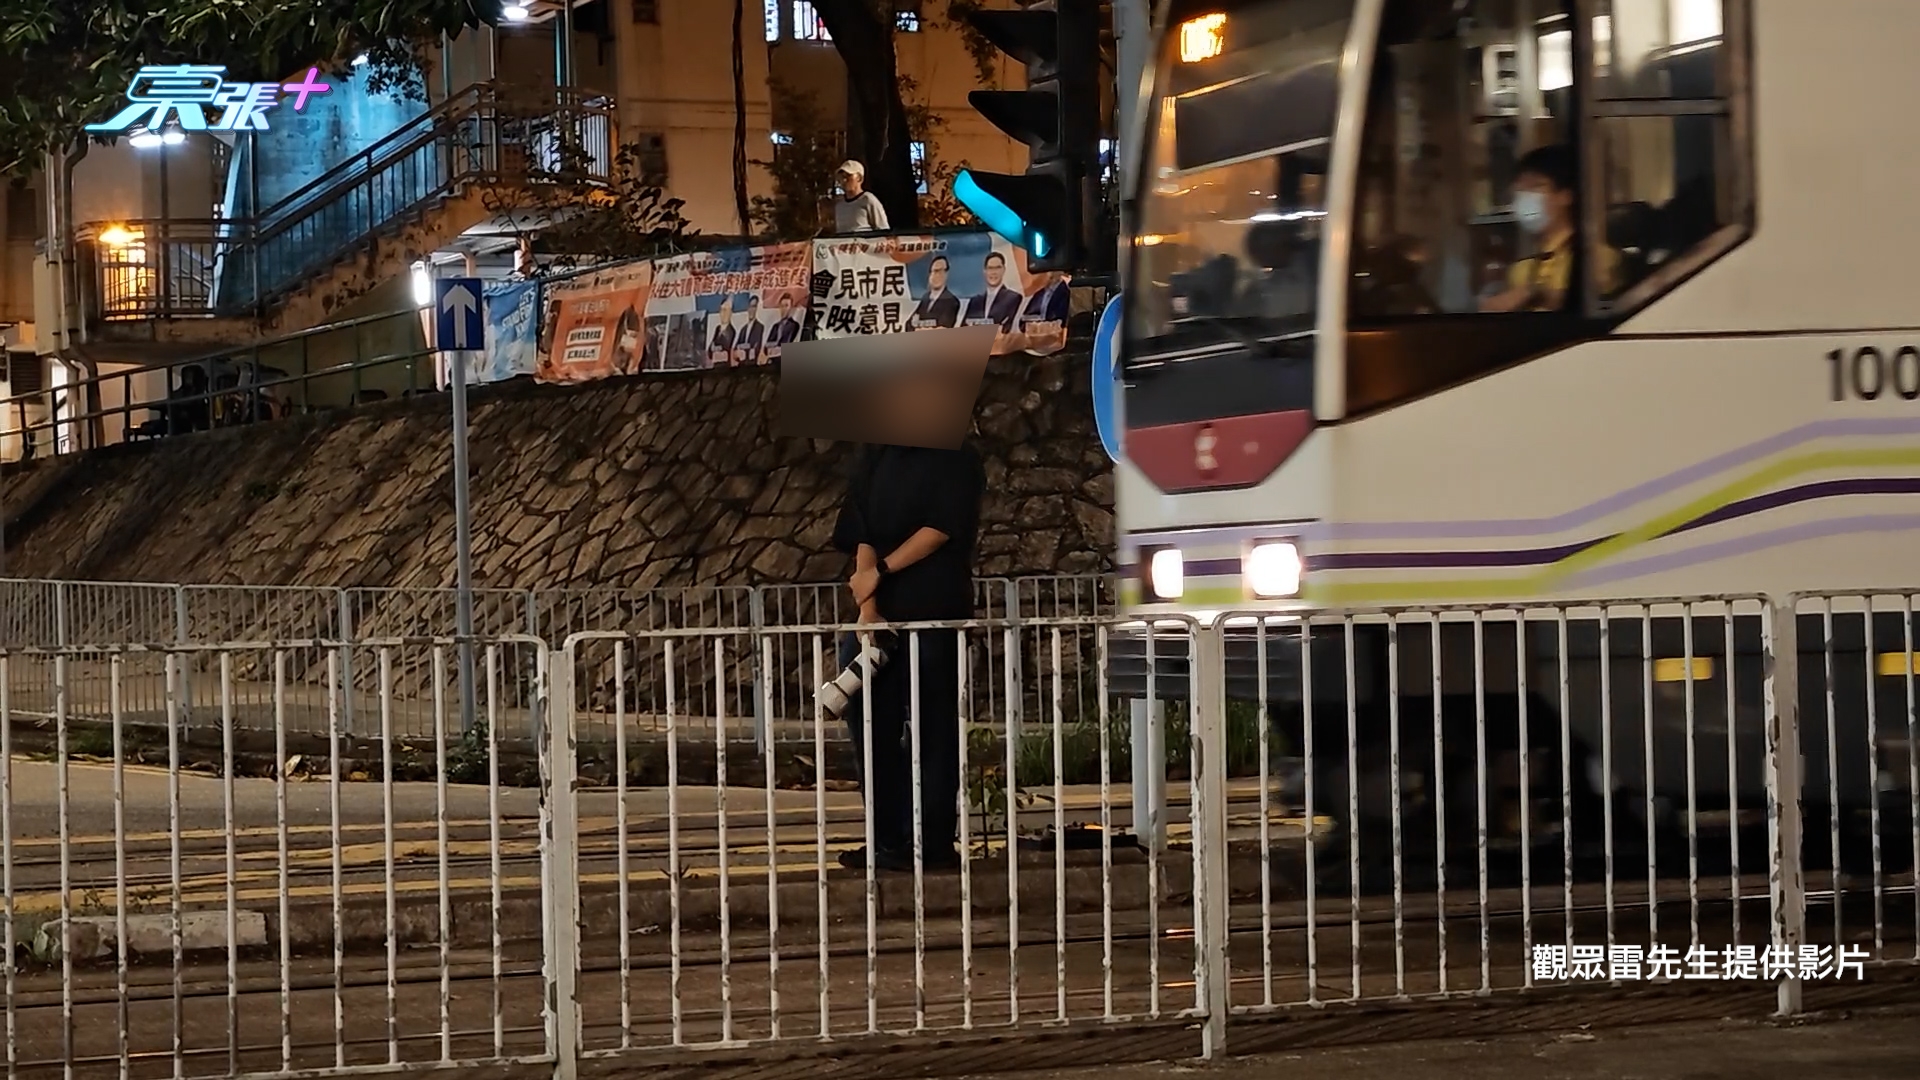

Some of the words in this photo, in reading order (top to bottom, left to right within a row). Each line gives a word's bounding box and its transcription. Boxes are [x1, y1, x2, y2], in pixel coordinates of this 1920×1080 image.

[812, 265, 905, 300] 會見市民
[1823, 345, 1920, 401] 100
